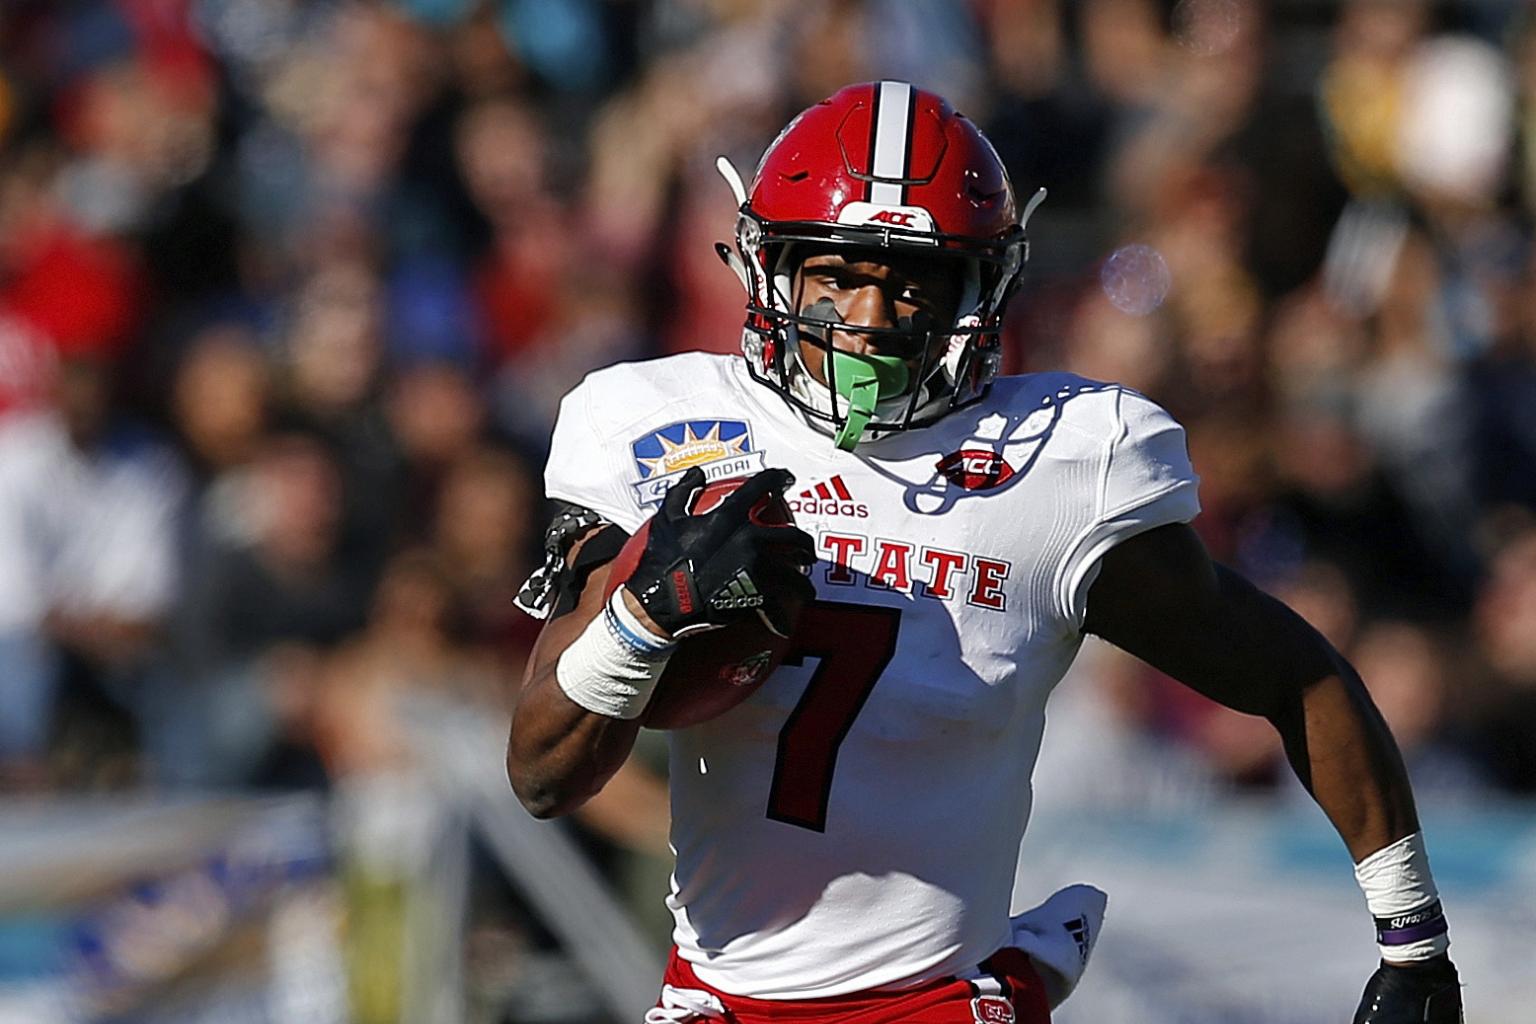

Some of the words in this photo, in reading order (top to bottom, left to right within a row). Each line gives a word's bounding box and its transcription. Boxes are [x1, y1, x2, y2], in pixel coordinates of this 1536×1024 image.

[868, 210, 917, 228] ACC
[788, 498, 869, 518] adidas
[800, 531, 1012, 612] TATE
[714, 594, 764, 610] adidas
[766, 599, 902, 833] 7
